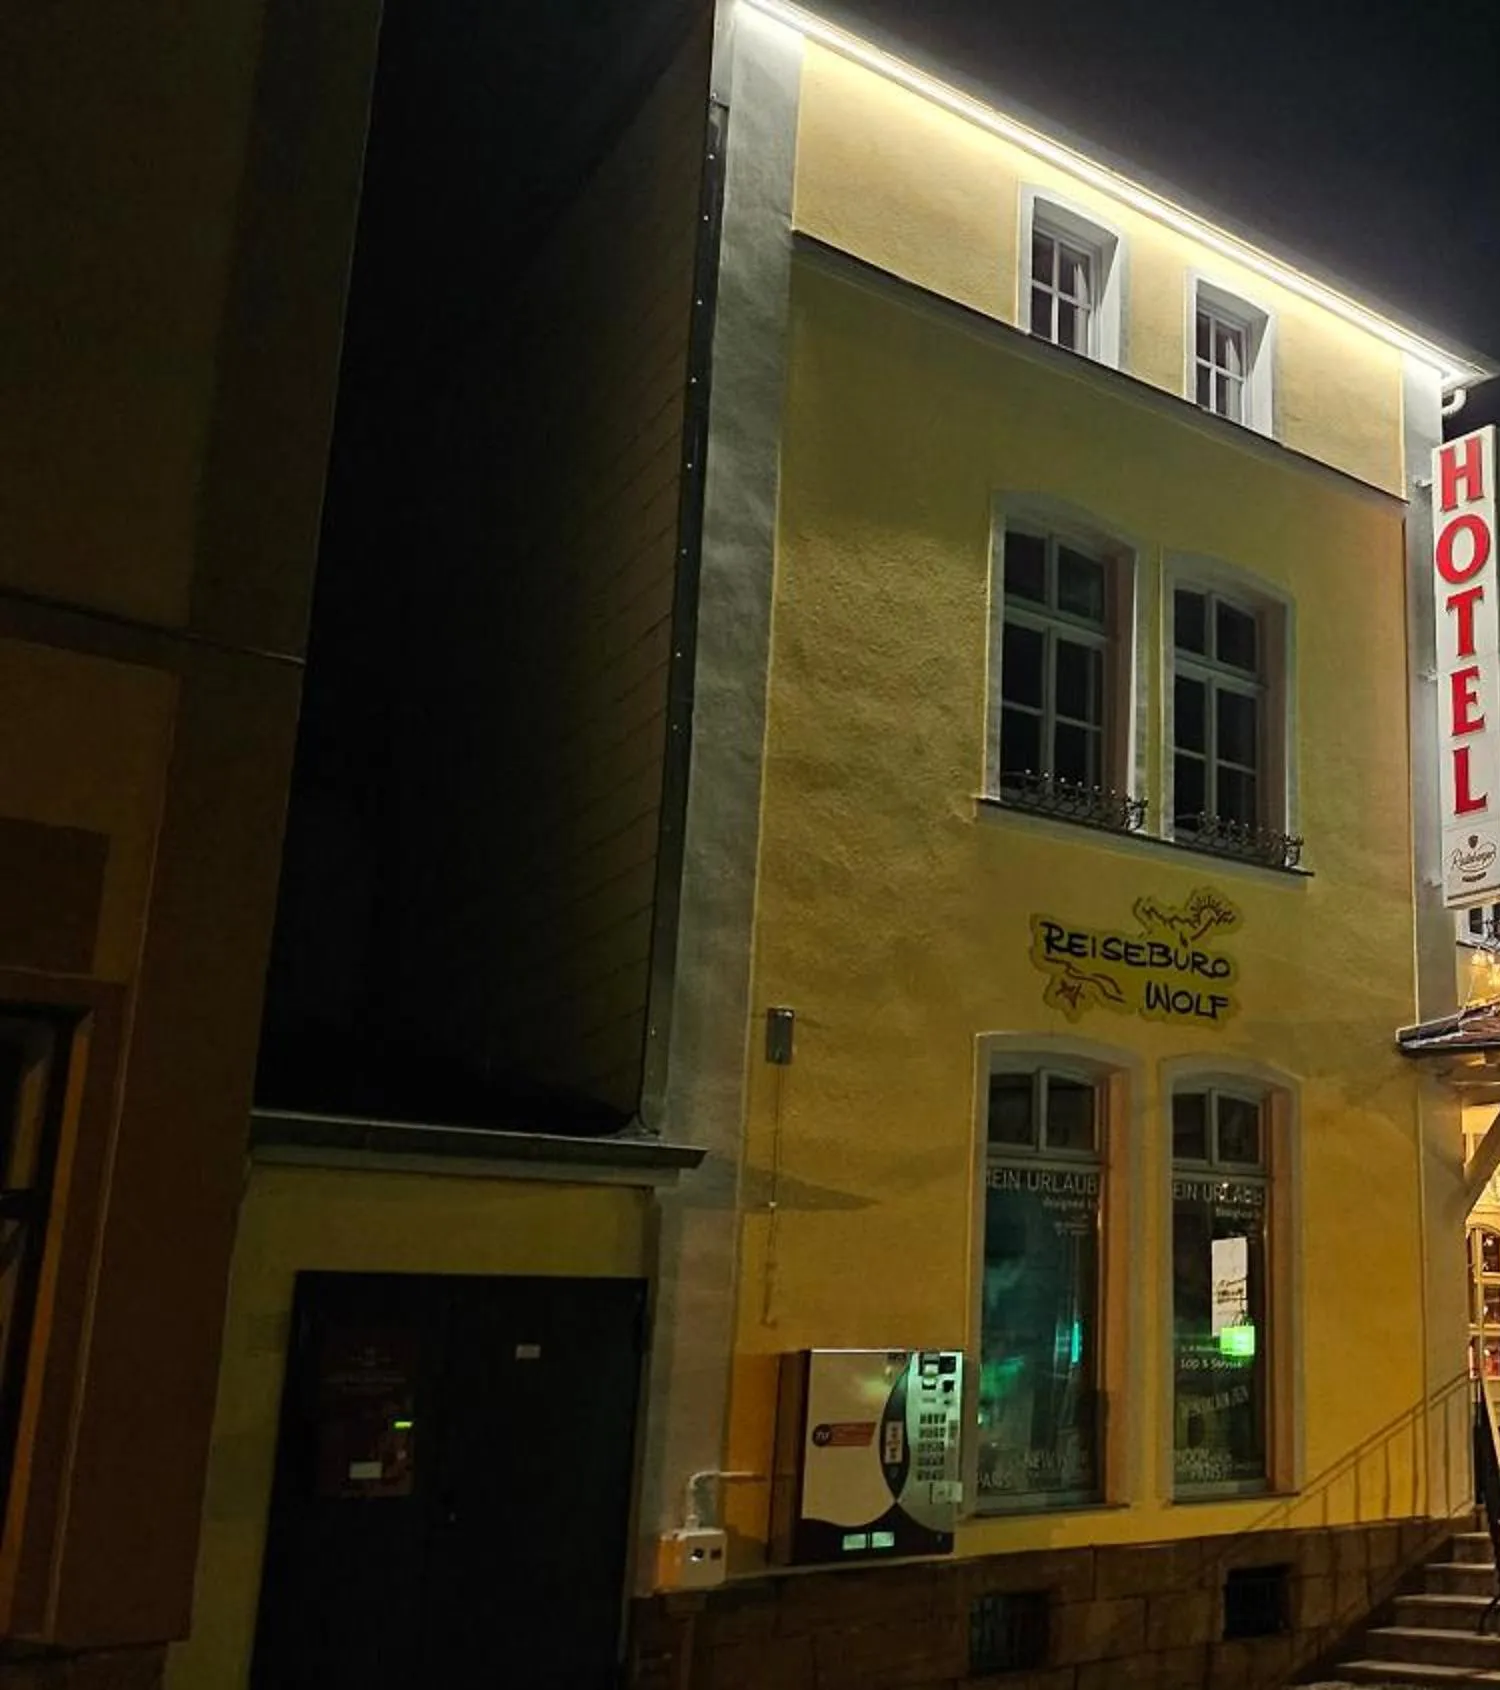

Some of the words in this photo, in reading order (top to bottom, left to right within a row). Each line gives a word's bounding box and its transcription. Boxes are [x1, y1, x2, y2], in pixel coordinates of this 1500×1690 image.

[1436, 437, 1492, 817] HOTEL
[1145, 980, 1229, 1019] WOLF
[1027, 1171, 1098, 1195] URLAUB
